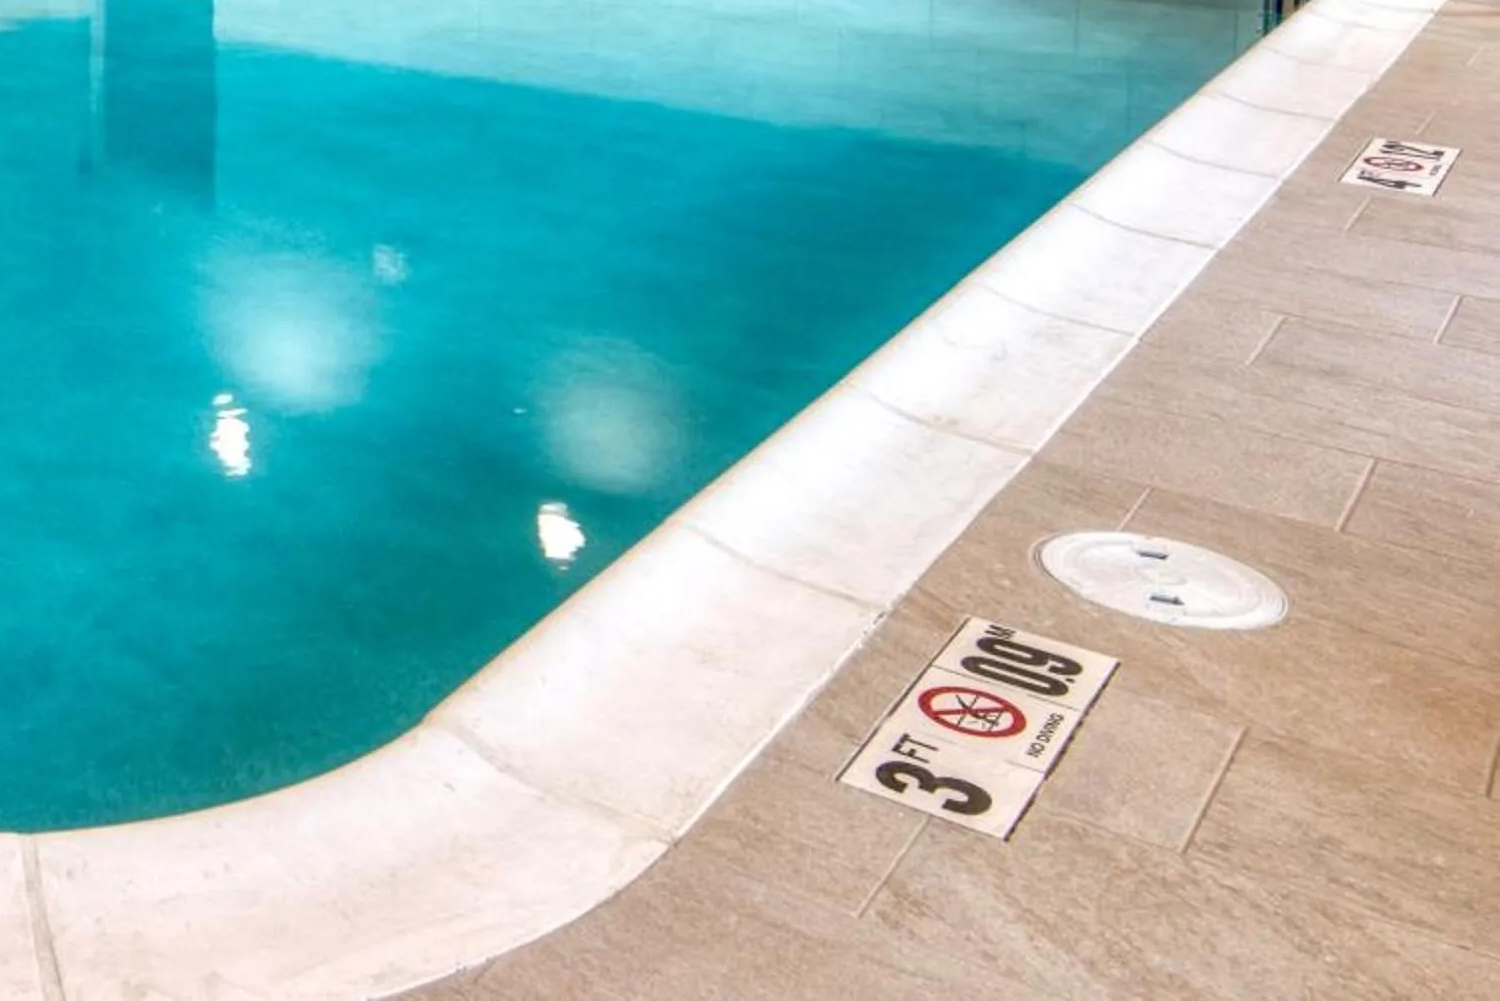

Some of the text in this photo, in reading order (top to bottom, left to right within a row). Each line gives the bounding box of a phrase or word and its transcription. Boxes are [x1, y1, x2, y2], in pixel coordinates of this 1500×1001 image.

[1027, 712, 1065, 759] NO DIVING
[875, 733, 993, 816] 3 FT
